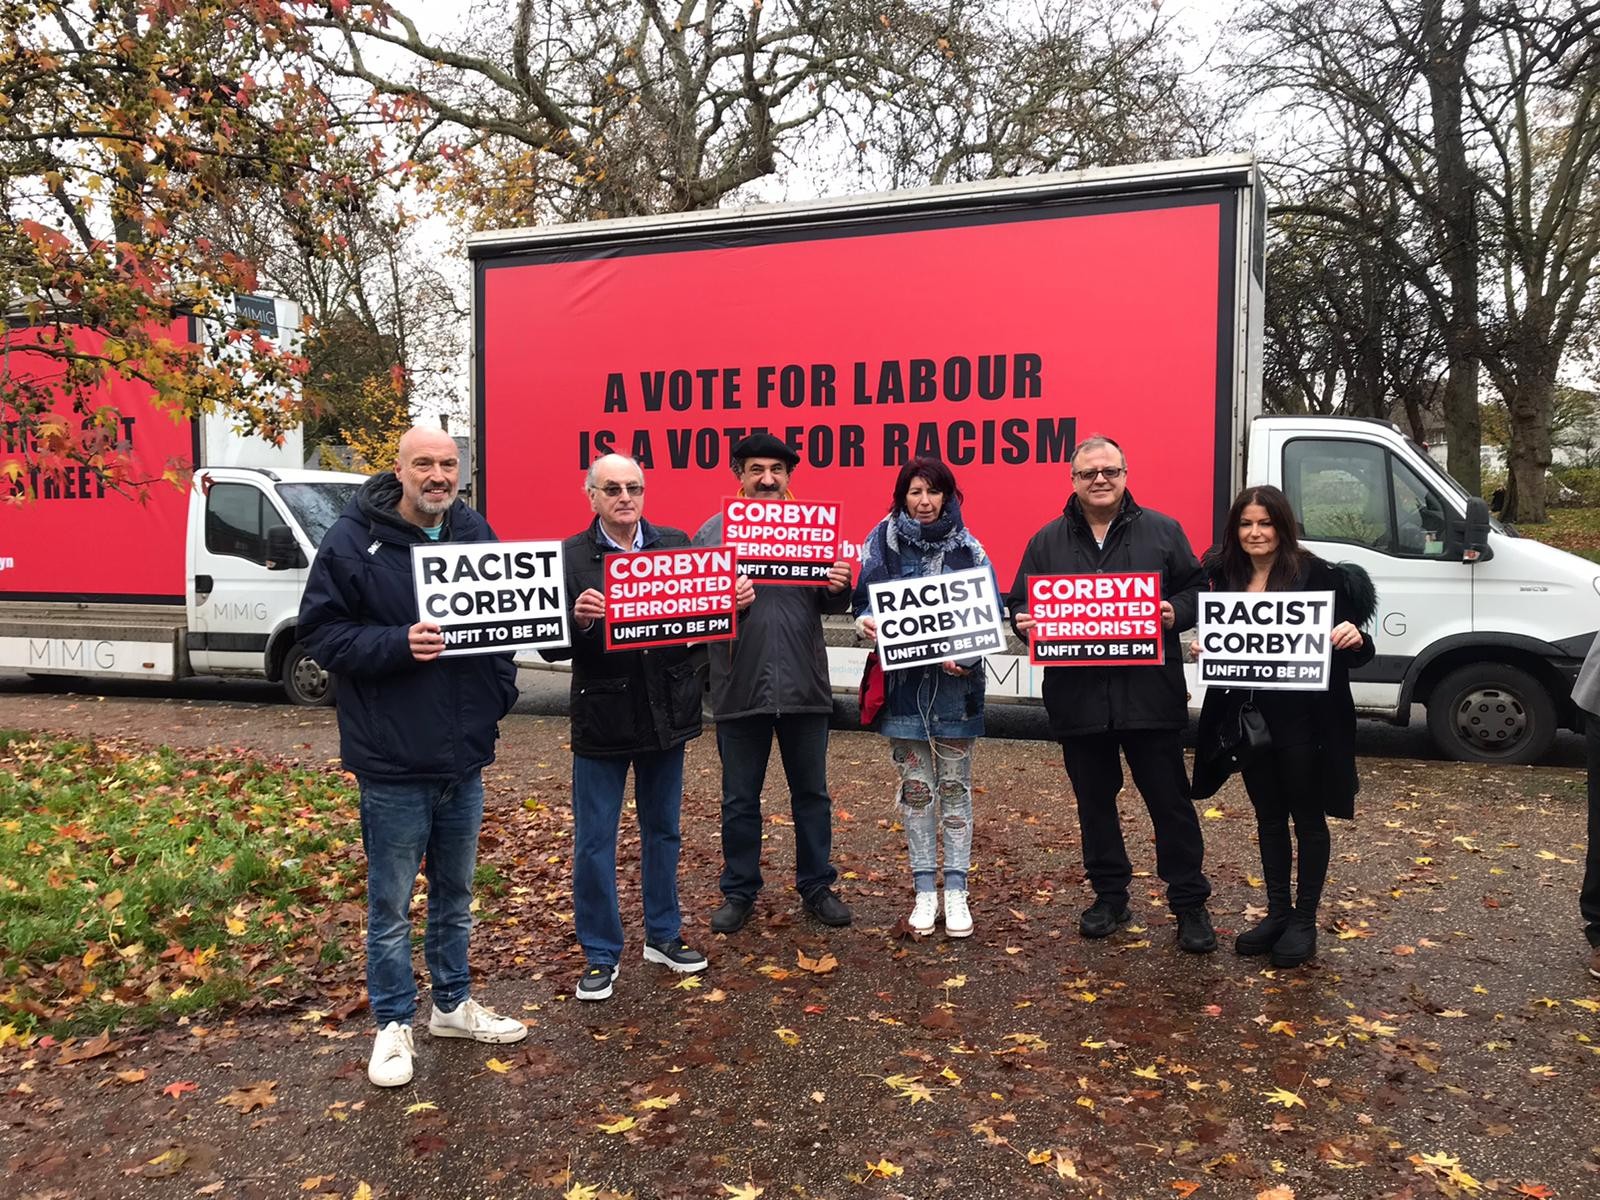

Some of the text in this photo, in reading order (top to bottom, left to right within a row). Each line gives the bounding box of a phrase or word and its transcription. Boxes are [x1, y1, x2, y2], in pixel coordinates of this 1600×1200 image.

[604, 353, 1042, 413] A VOTE FOR LABOUR
[631, 429, 654, 470] A
[785, 424, 865, 469] FOR
[883, 417, 1077, 467] RACISM
[727, 502, 836, 525] CORBYN
[727, 525, 835, 542] SUPPORTED
[422, 551, 557, 585] RACIST
[610, 551, 731, 579] CORBYN
[737, 563, 830, 577] NFIT TO BE PM
[610, 576, 732, 599] SUPPORTED
[876, 576, 986, 613] RACIST
[1033, 576, 1155, 600] CORBYN
[425, 586, 560, 618] CORBYN
[610, 595, 732, 618] TERRORISTS
[1033, 601, 1156, 618] SUPPORTED
[1204, 600, 1327, 625] RACIST
[486, 627, 508, 641] TO
[512, 625, 533, 639] BE
[536, 622, 560, 637] PM
[614, 618, 729, 639] UNFIT TO BE PM
[881, 604, 994, 639] CORBYN
[1035, 620, 1157, 637] TERRORISTS
[887, 633, 996, 661] UNFIT TO BE PM
[1037, 643, 1154, 656] UNFIT TO BE PM
[1204, 632, 1325, 654] CORBYN
[1206, 664, 1320, 678] UNFIT TO BE PM
